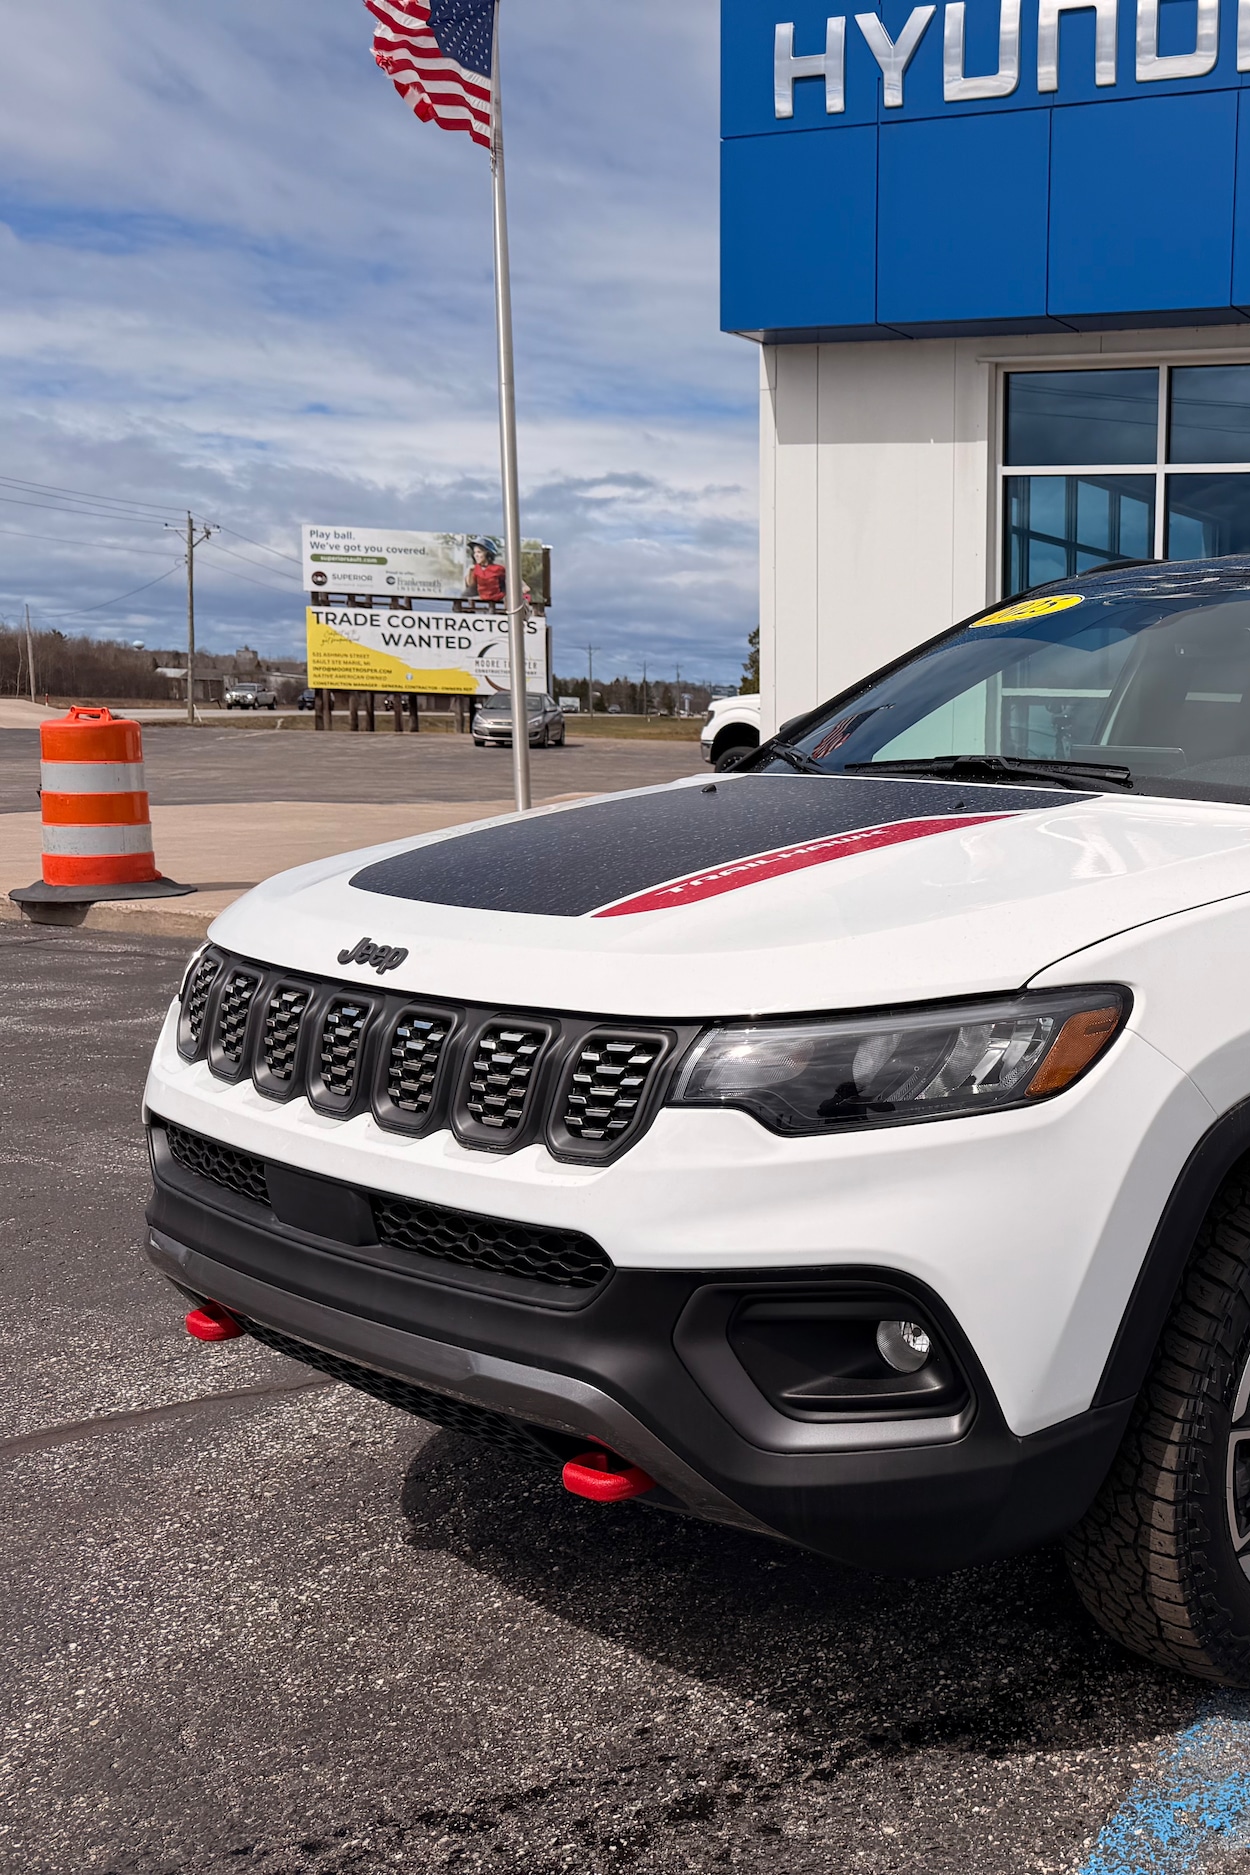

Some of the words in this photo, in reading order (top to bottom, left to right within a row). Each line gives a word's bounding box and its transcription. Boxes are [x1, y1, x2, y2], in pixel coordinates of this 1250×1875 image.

[310, 529, 331, 541] Play
[333, 531, 356, 541] ball.
[310, 541, 341, 551] We've
[343, 543, 362, 553] got
[364, 545, 383, 555] you
[386, 545, 429, 556] covered.
[319, 555, 378, 564] superiorsault.com
[331, 573, 373, 582] SUPERIOR
[397, 586, 442, 594] INSURANCE
[312, 611, 381, 627] TRADE
[387, 614, 538, 635] CONTRACTOS
[381, 633, 472, 650] WANTED
[475, 659, 500, 668] MOORE
[655, 828, 892, 897] TRAILHAWK
[337, 937, 409, 976] Jeep
